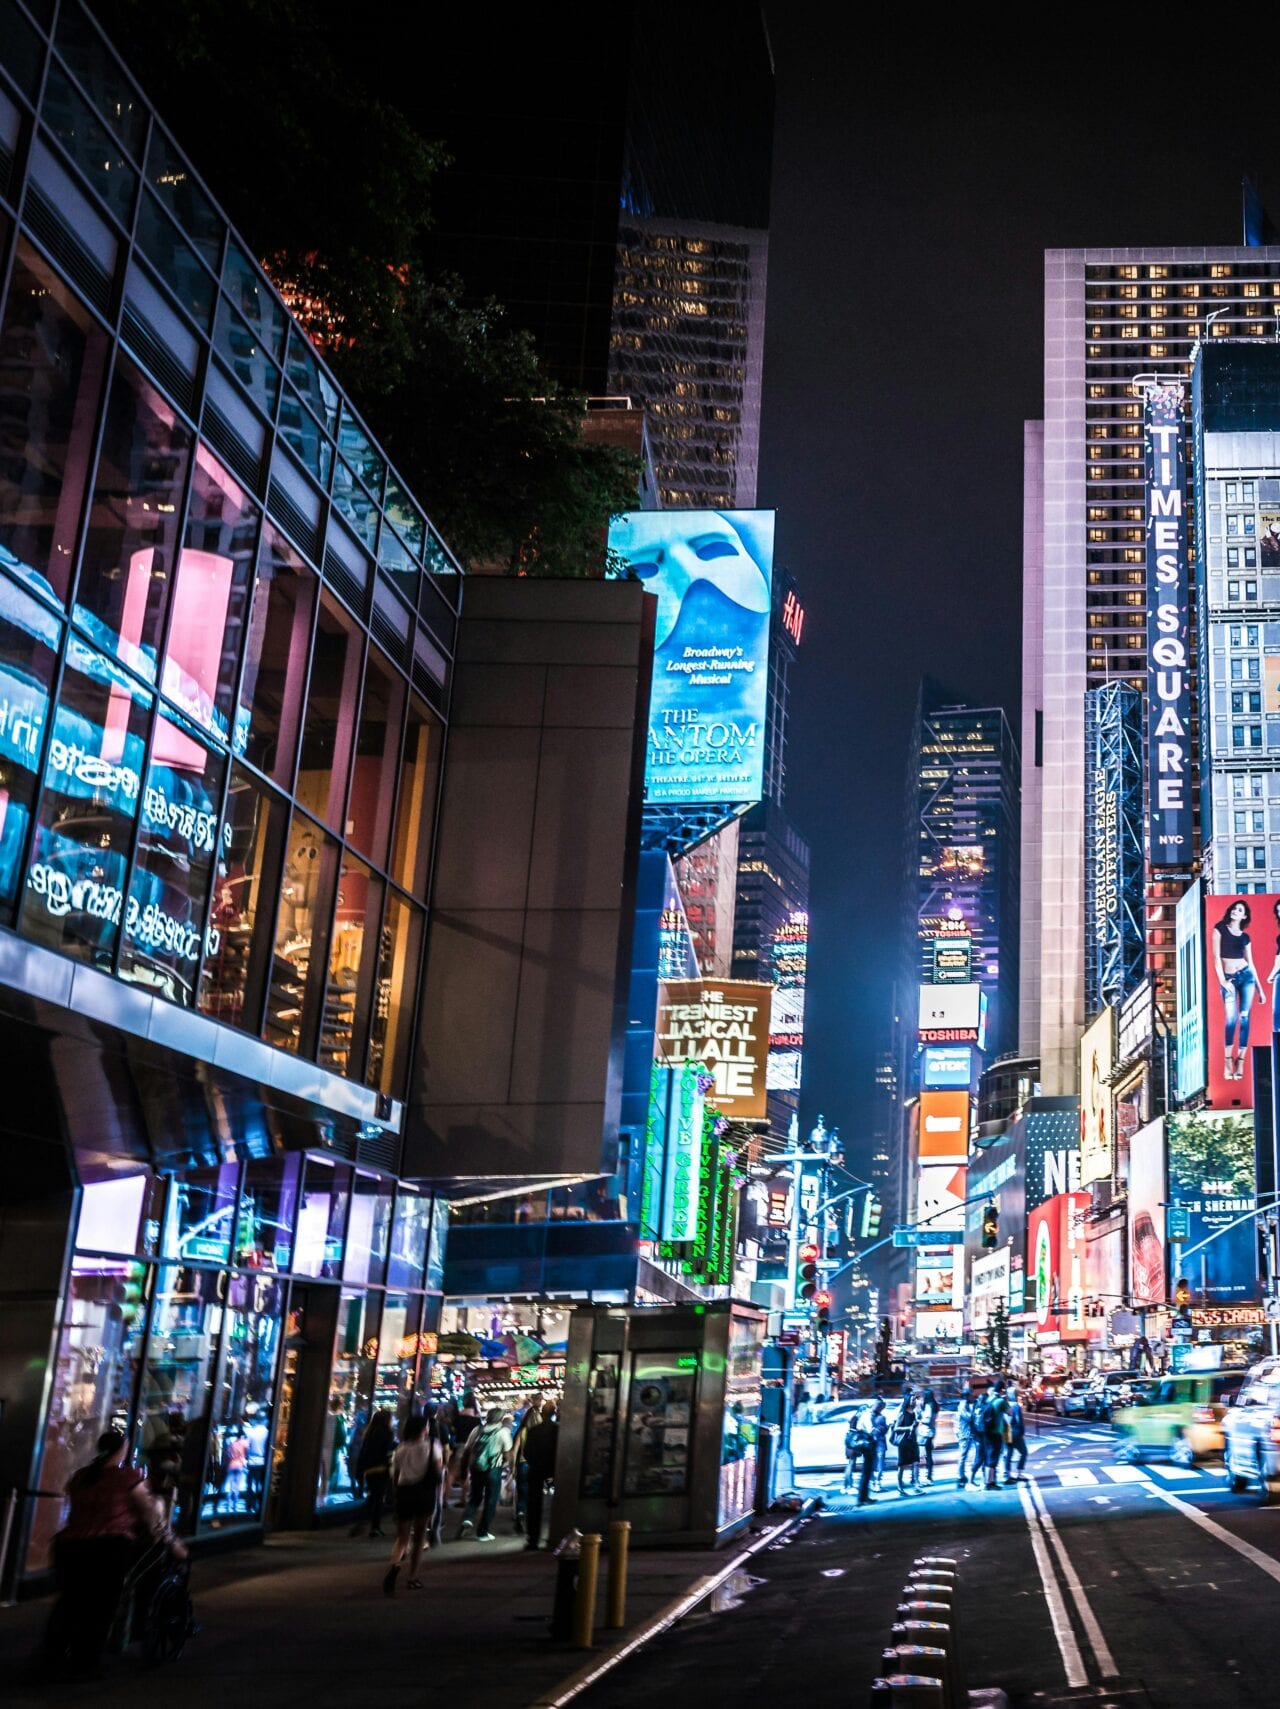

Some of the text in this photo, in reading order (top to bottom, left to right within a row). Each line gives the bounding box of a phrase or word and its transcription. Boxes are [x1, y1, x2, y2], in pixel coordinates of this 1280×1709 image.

[1150, 425, 1187, 810] TIMES SQUARE
[683, 646, 743, 659] Broadway's
[666, 659, 755, 673] Longest-Running
[689, 673, 732, 685] Musical
[661, 709, 698, 723] THE
[648, 722, 758, 749] ANTOM
[651, 750, 743, 765] HE OPERA
[1159, 834, 1184, 846] NYC
[1095, 767, 1106, 943] AMERICAN EAGLE
[1106, 790, 1118, 912] OUTFITTERS
[703, 1004, 758, 1022] NIEST
[706, 1022, 757, 1040] ICAL
[919, 1030, 978, 1041] TOSHIBA
[671, 1076, 696, 1237] OLIVE GARDEN
[1044, 1150, 1081, 1195] NE
[1205, 1199, 1257, 1212] SHERMAN
